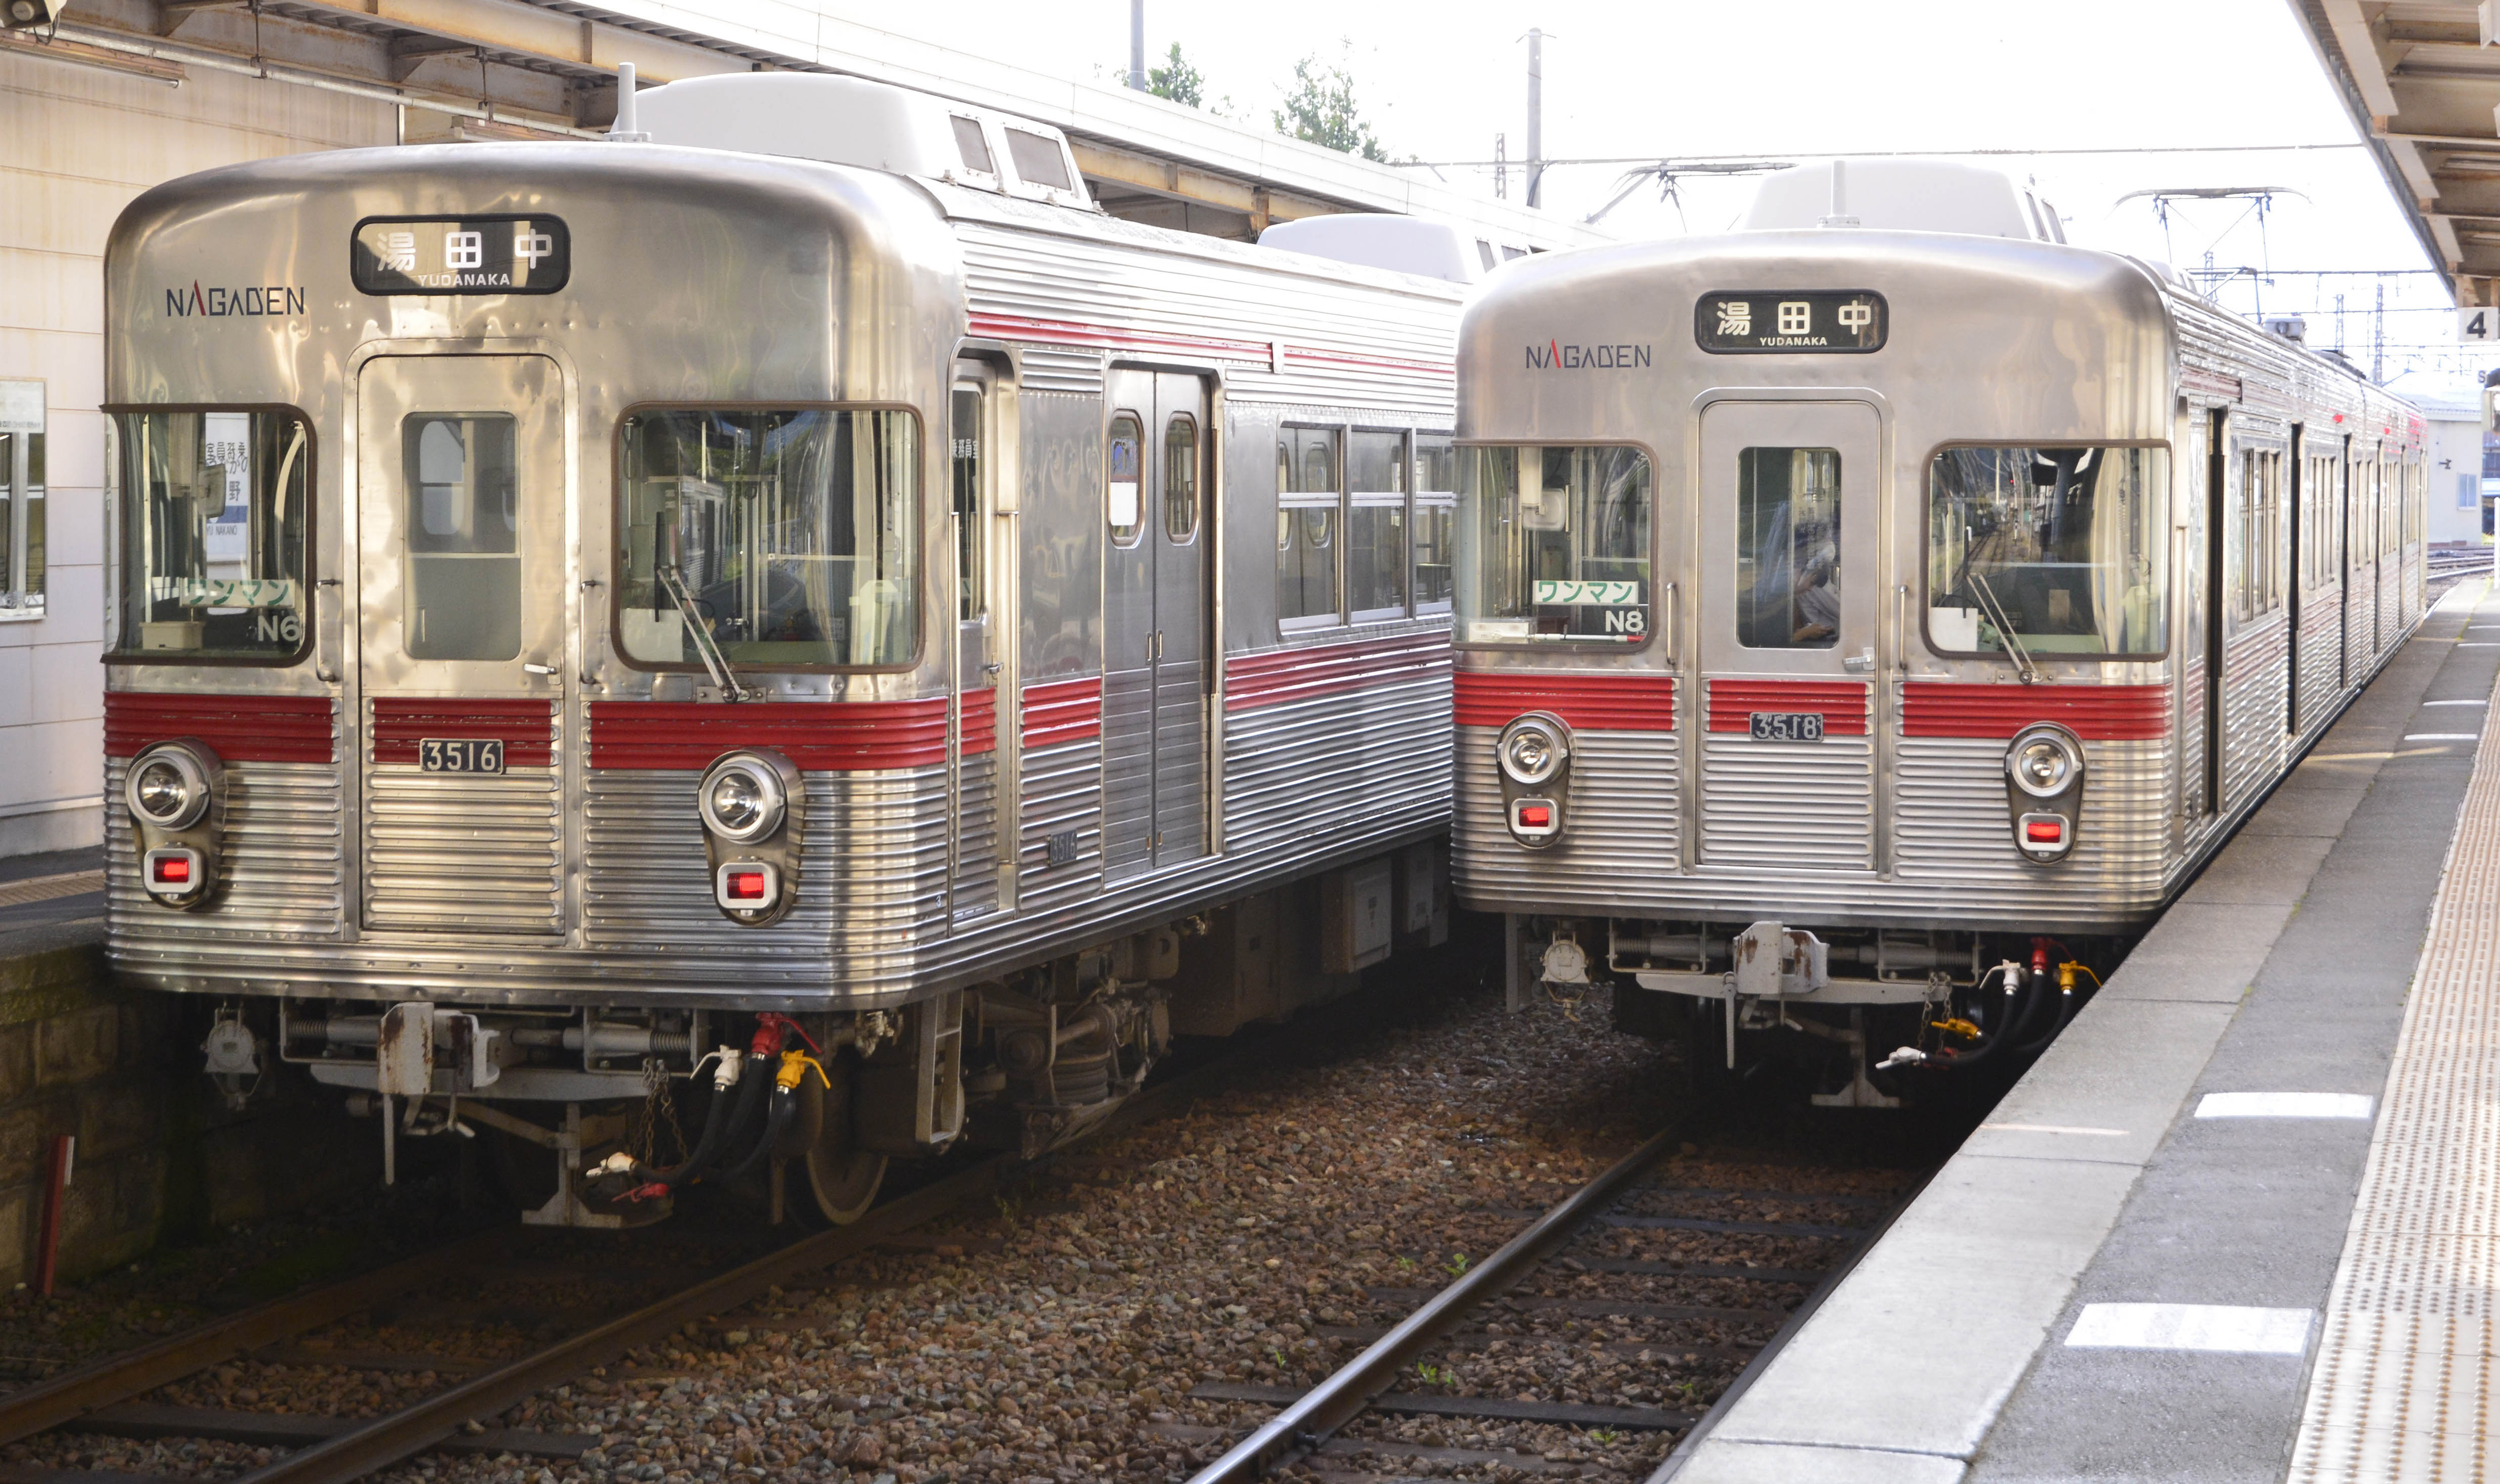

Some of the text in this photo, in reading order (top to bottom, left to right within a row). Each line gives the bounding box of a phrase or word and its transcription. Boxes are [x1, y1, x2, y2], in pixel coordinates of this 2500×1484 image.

[377, 228, 552, 271] 湯田中
[418, 274, 510, 287] YUDANAKA
[166, 279, 304, 317] NAGADEN
[1717, 300, 1871, 335] 湯田中
[2467, 311, 2486, 338] 4
[1526, 338, 1650, 369] NAGADEN
[1760, 337, 1827, 346] YUDANAKA
[188, 579, 288, 605] ワンマン
[1539, 581, 1632, 603] ワンマン
[257, 615, 301, 642] N6
[1605, 610, 1644, 632] N8
[1756, 714, 1816, 739] 3518
[427, 742, 495, 771] 3516
[1052, 832, 1075, 861] 3516
